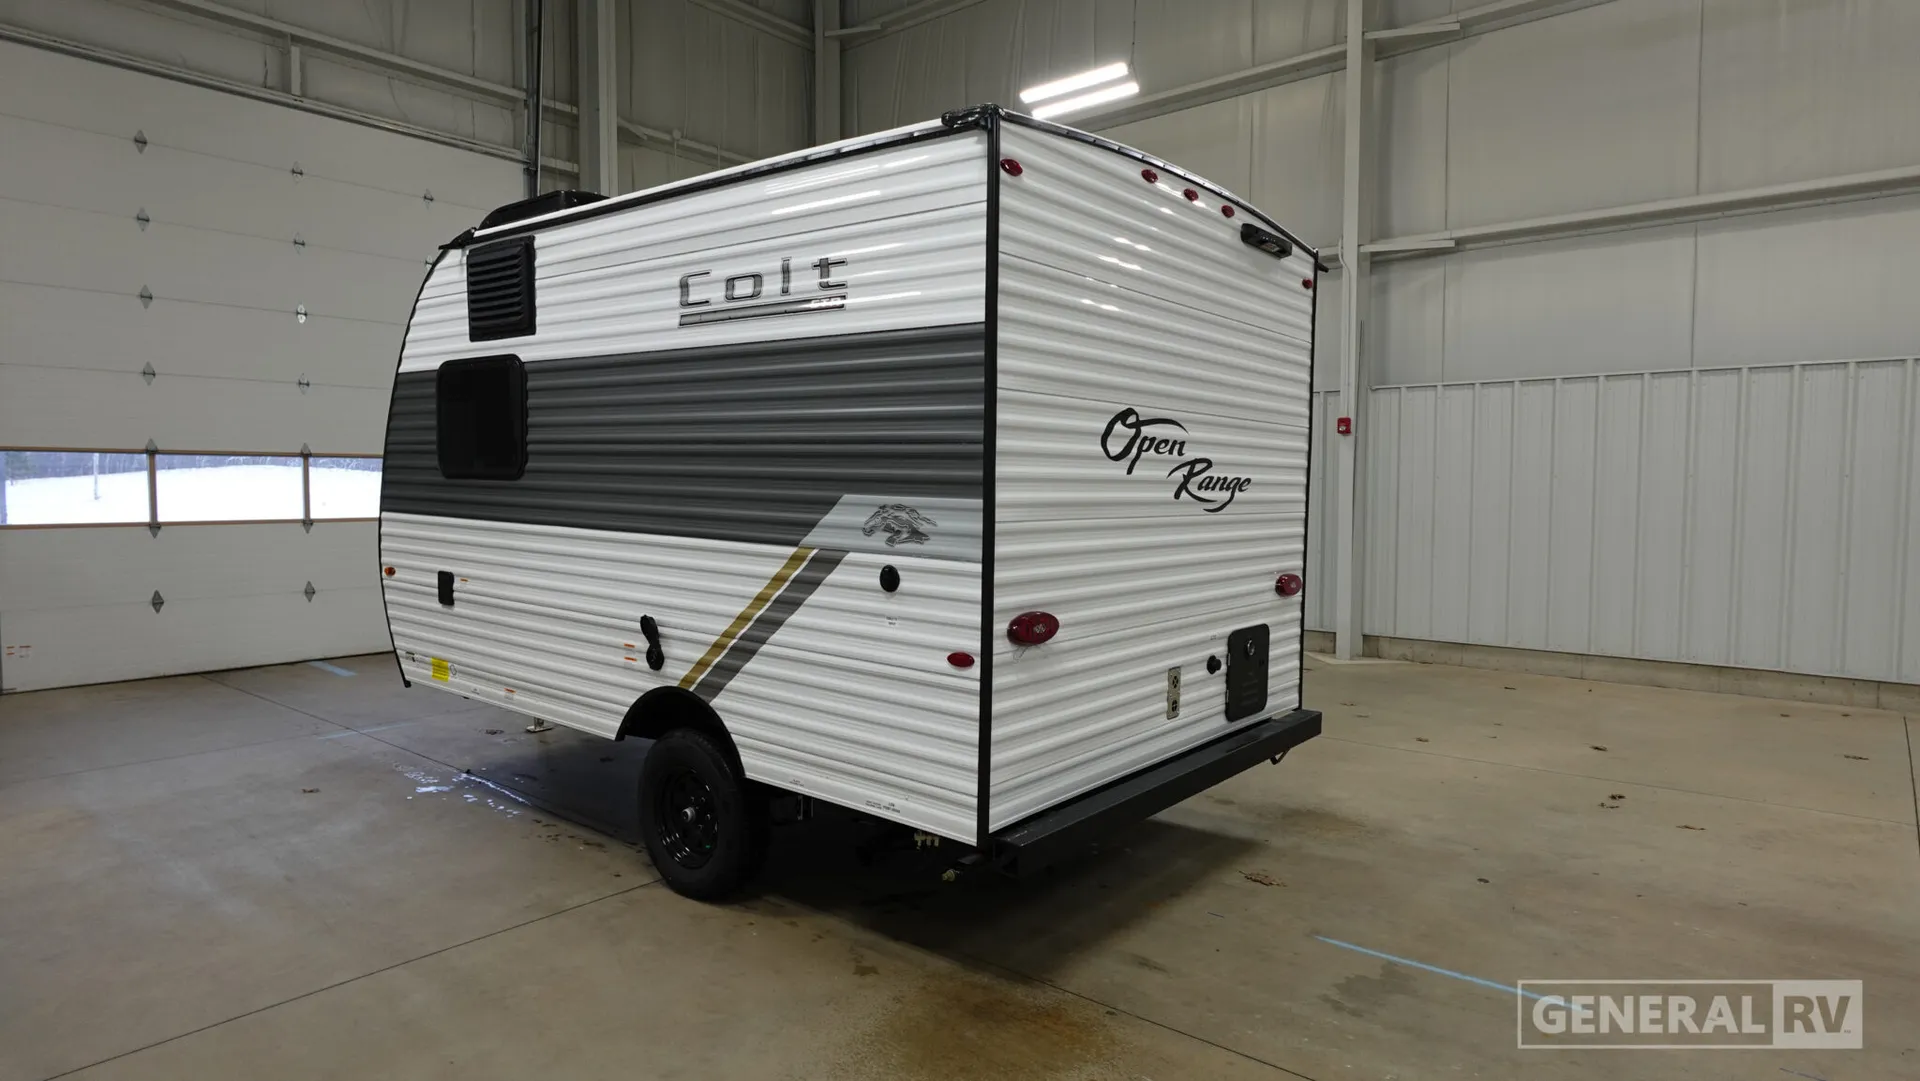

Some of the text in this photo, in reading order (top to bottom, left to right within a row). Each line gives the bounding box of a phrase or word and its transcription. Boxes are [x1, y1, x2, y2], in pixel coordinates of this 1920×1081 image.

[679, 257, 848, 307] Colt
[1101, 407, 1189, 475] Open
[1166, 458, 1252, 513] Range
